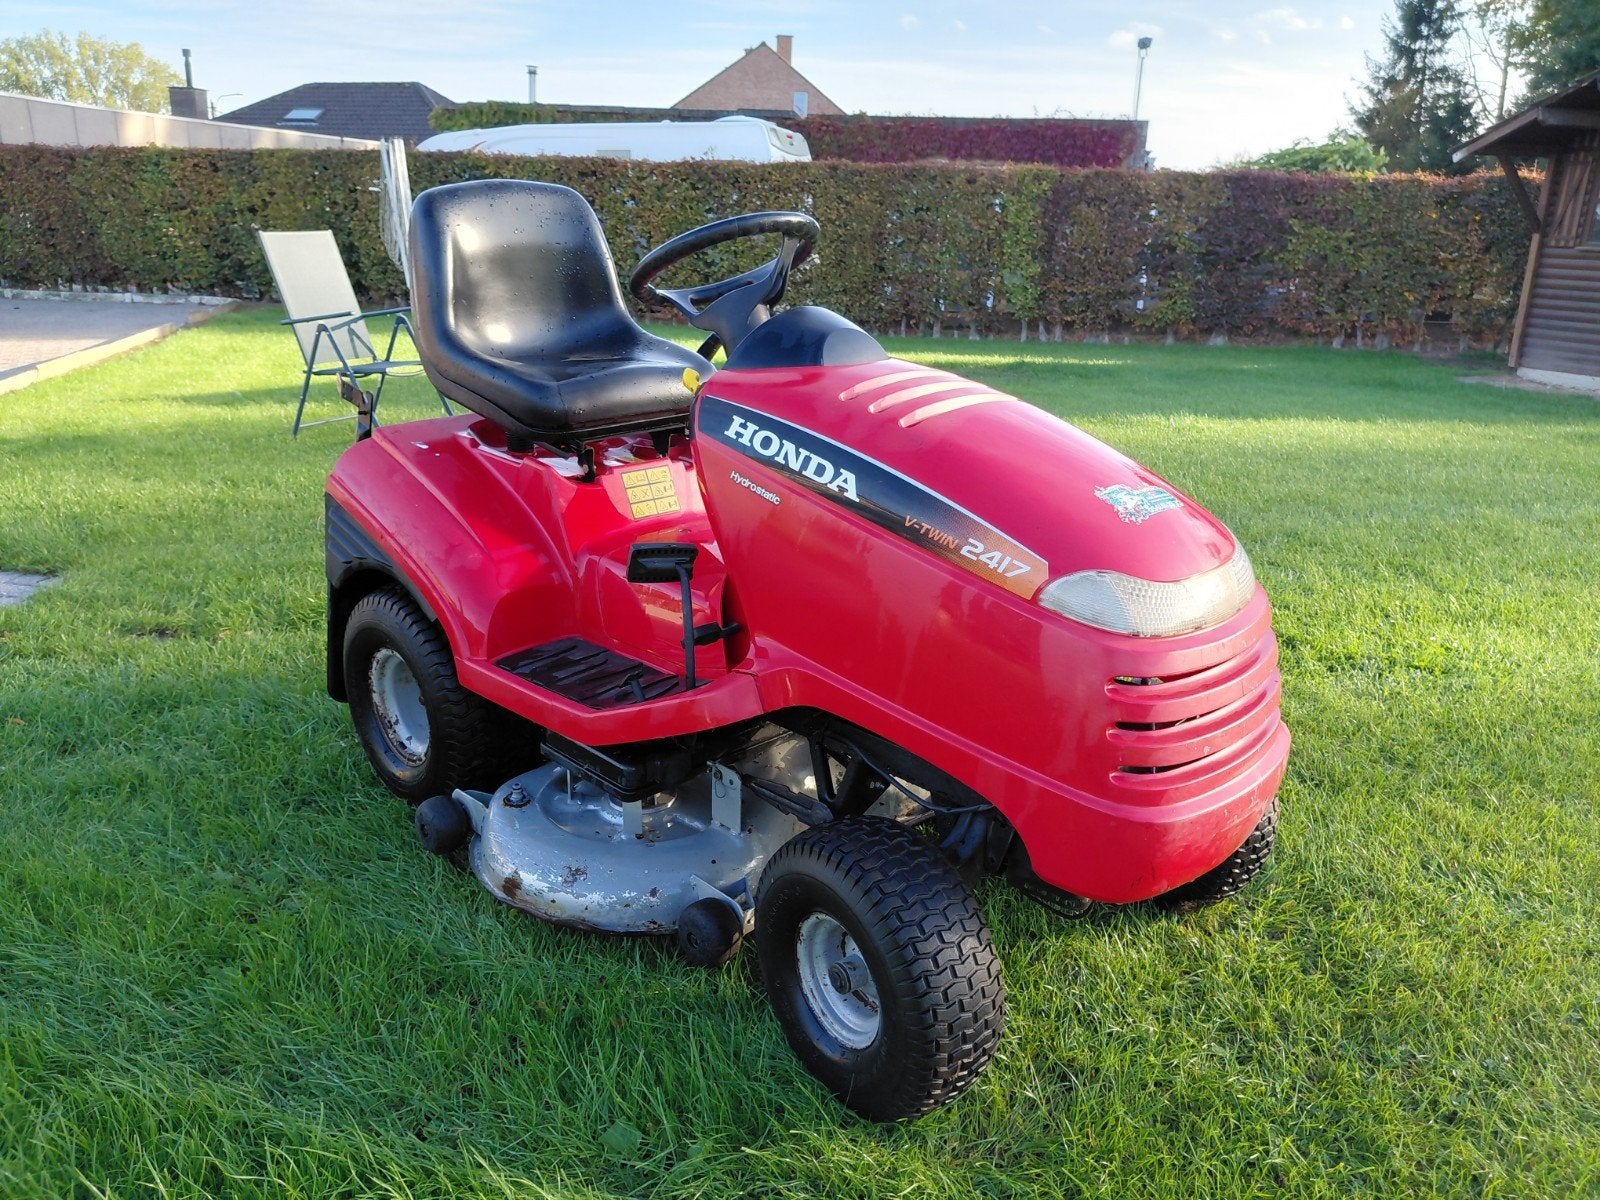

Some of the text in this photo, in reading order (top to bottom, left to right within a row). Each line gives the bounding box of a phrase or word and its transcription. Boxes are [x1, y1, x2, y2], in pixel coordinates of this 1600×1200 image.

[724, 415, 860, 502] HONDA
[729, 470, 781, 505] Hydrostatic
[904, 514, 1031, 577] V-TWIN 2417
